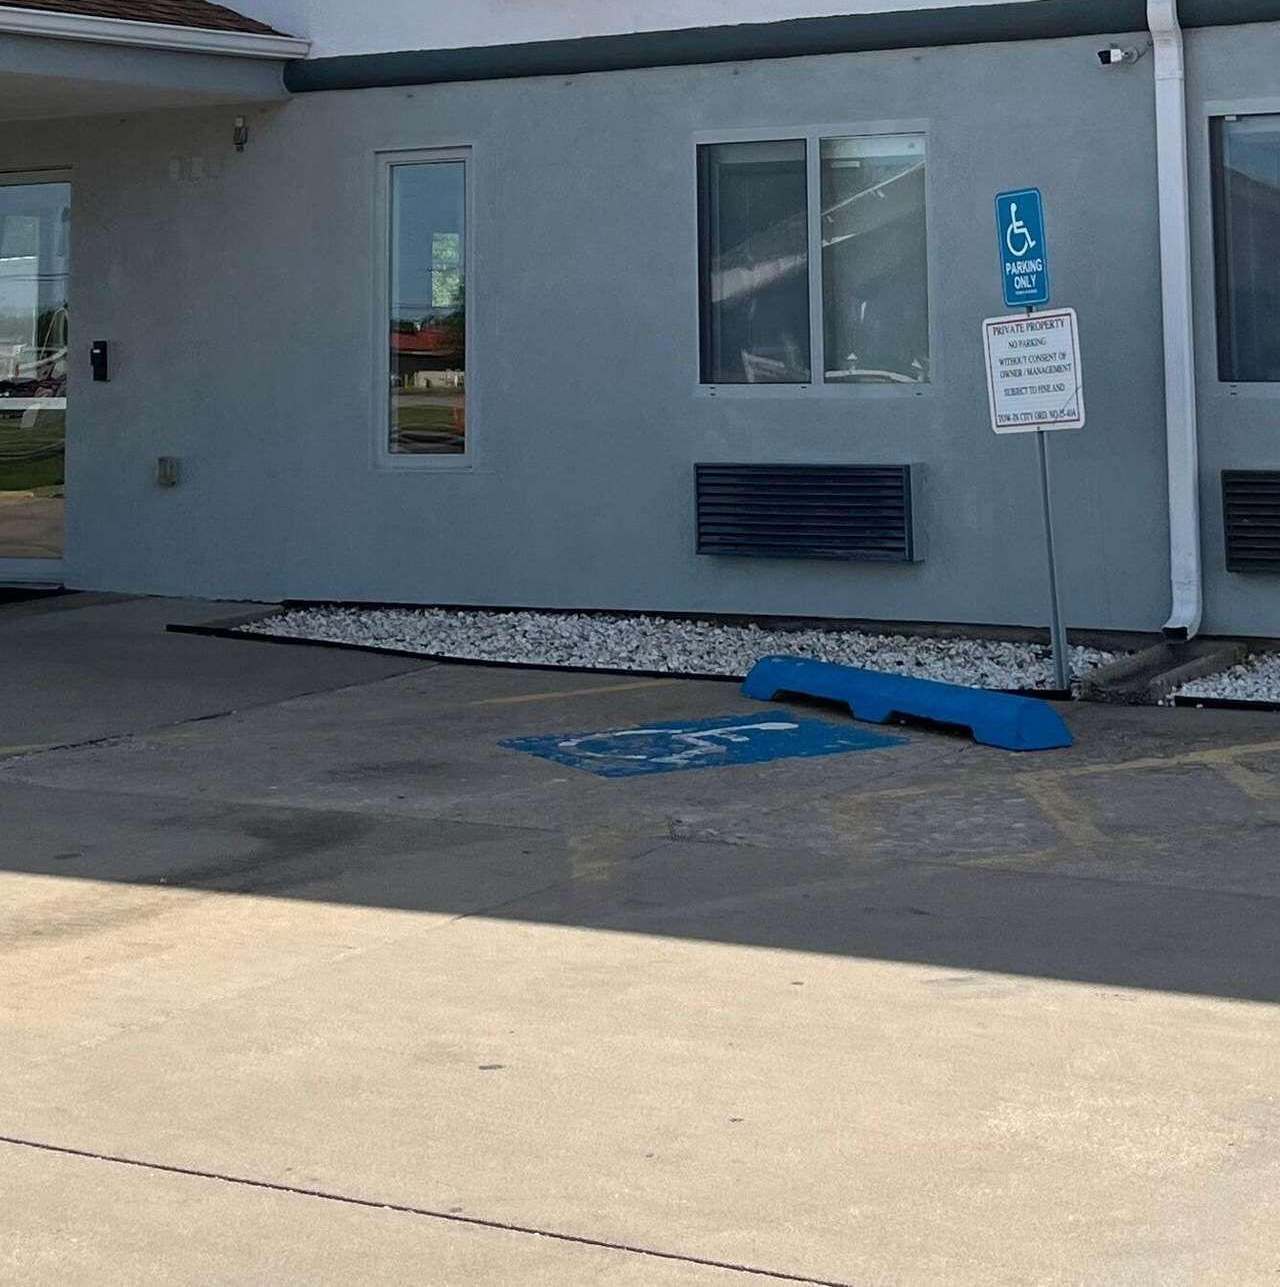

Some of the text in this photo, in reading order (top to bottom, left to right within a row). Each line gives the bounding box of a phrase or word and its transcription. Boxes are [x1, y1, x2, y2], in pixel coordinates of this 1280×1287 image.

[1005, 258, 1043, 275] PARKING
[1014, 274, 1036, 289] ONLY
[992, 318, 1065, 336] PRIVATE PROPERTY
[1008, 337, 1047, 349] NO PARKING
[1028, 353, 1057, 364] CONSENT
